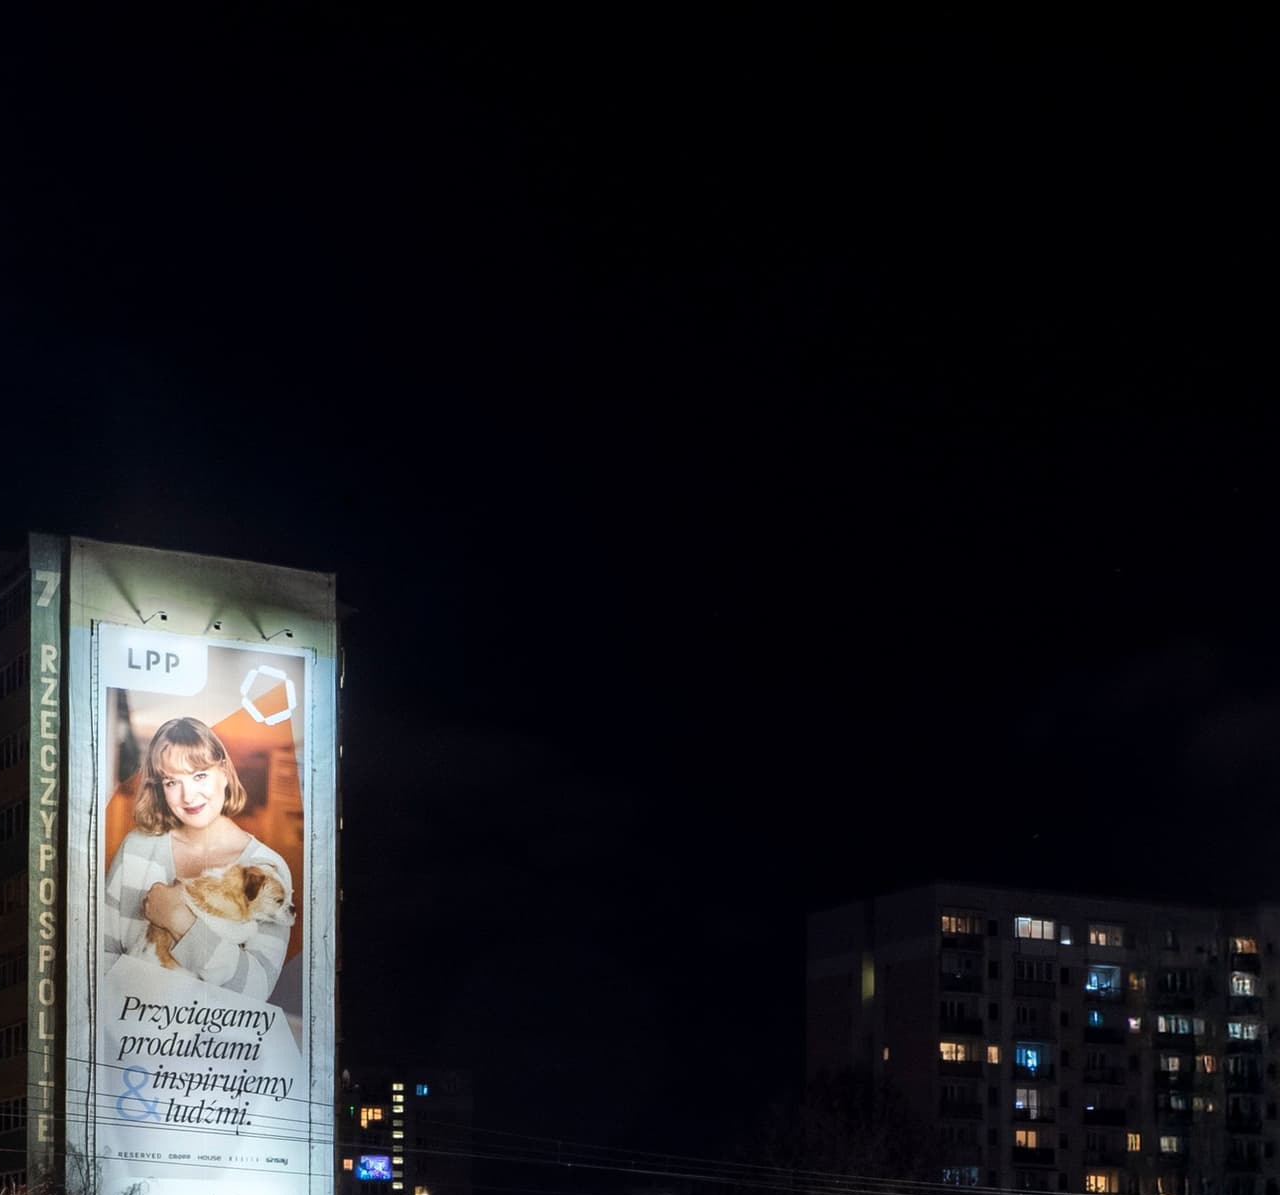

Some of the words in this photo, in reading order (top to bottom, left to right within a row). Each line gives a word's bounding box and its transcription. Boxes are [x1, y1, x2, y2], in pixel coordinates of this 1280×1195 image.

[34, 570, 61, 607] 7
[127, 647, 180, 673] LPP
[118, 995, 276, 1036] Przyciągamy
[116, 1032, 263, 1061] produktami
[115, 1064, 161, 1122] &
[152, 1064, 294, 1102] inspirujemy
[165, 1098, 252, 1126] ludźmi.
[118, 1152, 162, 1160] RESERVED
